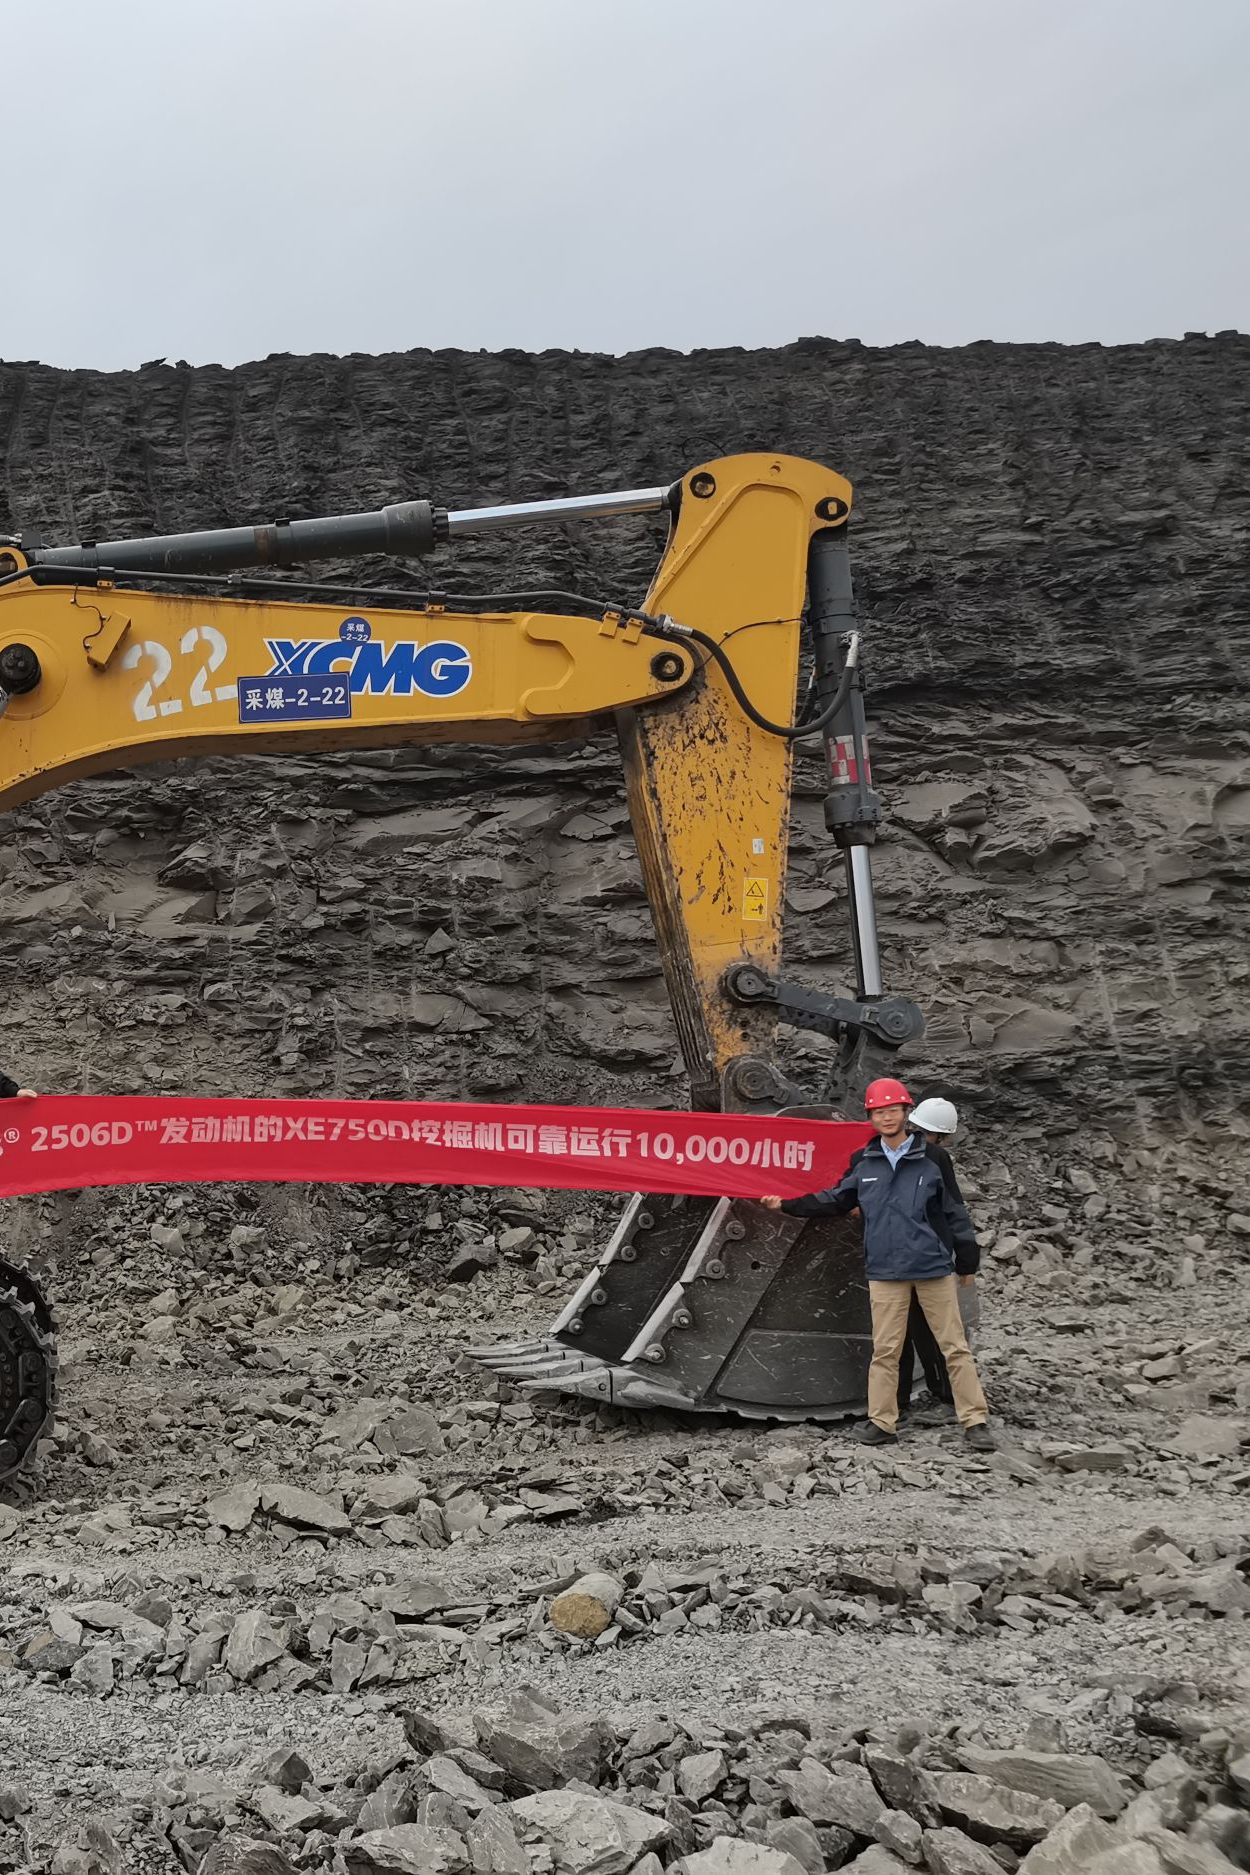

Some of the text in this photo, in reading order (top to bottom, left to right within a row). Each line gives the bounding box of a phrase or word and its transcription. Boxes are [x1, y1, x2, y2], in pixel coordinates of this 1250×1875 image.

[346, 623, 365, 632] 采煤
[124, 625, 239, 722] 22
[263, 637, 472, 698] XCMG
[245, 686, 346, 711] 采煤-2-22
